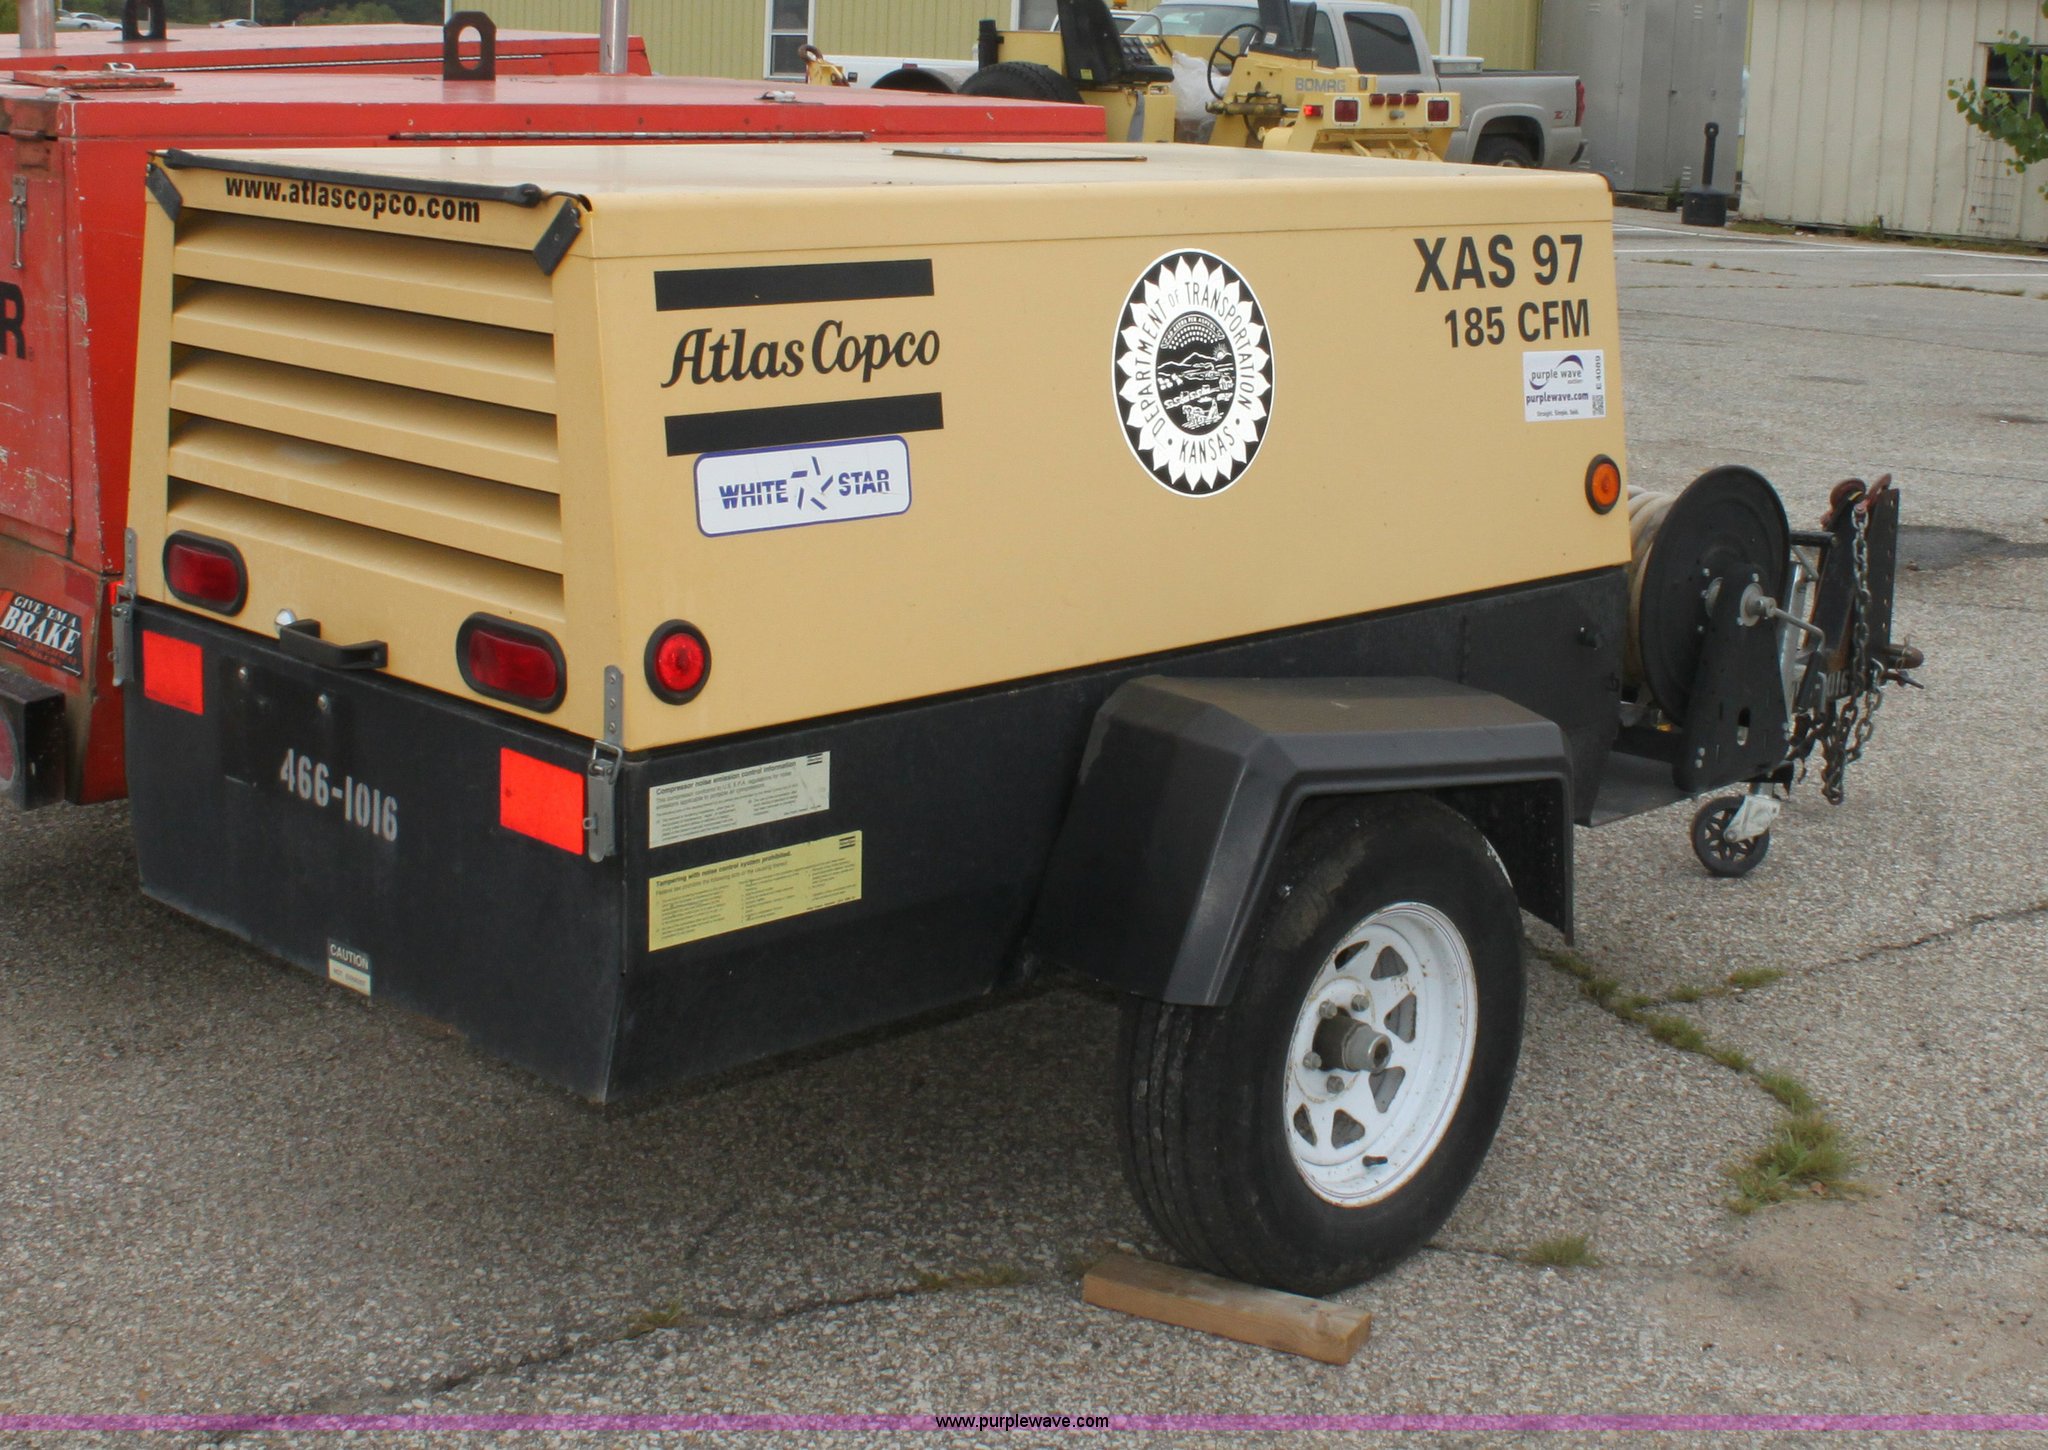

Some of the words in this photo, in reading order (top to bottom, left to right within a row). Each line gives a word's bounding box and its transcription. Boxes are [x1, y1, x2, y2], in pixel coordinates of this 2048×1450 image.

[1295, 77, 1346, 93] BOMAG
[225, 176, 481, 224] www.atlascopco.com
[1412, 233, 1516, 293] XAS
[1531, 233, 1583, 286] 97
[1444, 306, 1506, 348] 185
[1517, 298, 1591, 343] CFM
[661, 327, 805, 389] Atlas
[811, 319, 941, 384] Copco
[1135, 298, 1168, 438] DEPARTMENT
[1184, 281, 1256, 411] TRANSPORTATION
[1531, 369, 1558, 382] purple
[1560, 370, 1582, 378] wave
[1526, 392, 1589, 406] purplewave.com
[1178, 425, 1236, 465] KANSAS
[717, 478, 789, 511] WHITE
[838, 468, 892, 497] STAR
[0, 605, 82, 655] BRAKE
[14, 595, 44, 615] GIVE
[47, 605, 68, 623] 'EM
[68, 616, 77, 628] A
[280, 748, 398, 842] 466-1016
[656, 781, 694, 796] Compressor
[656, 874, 688, 888] Tampering
[330, 943, 369, 970] CAUTION
